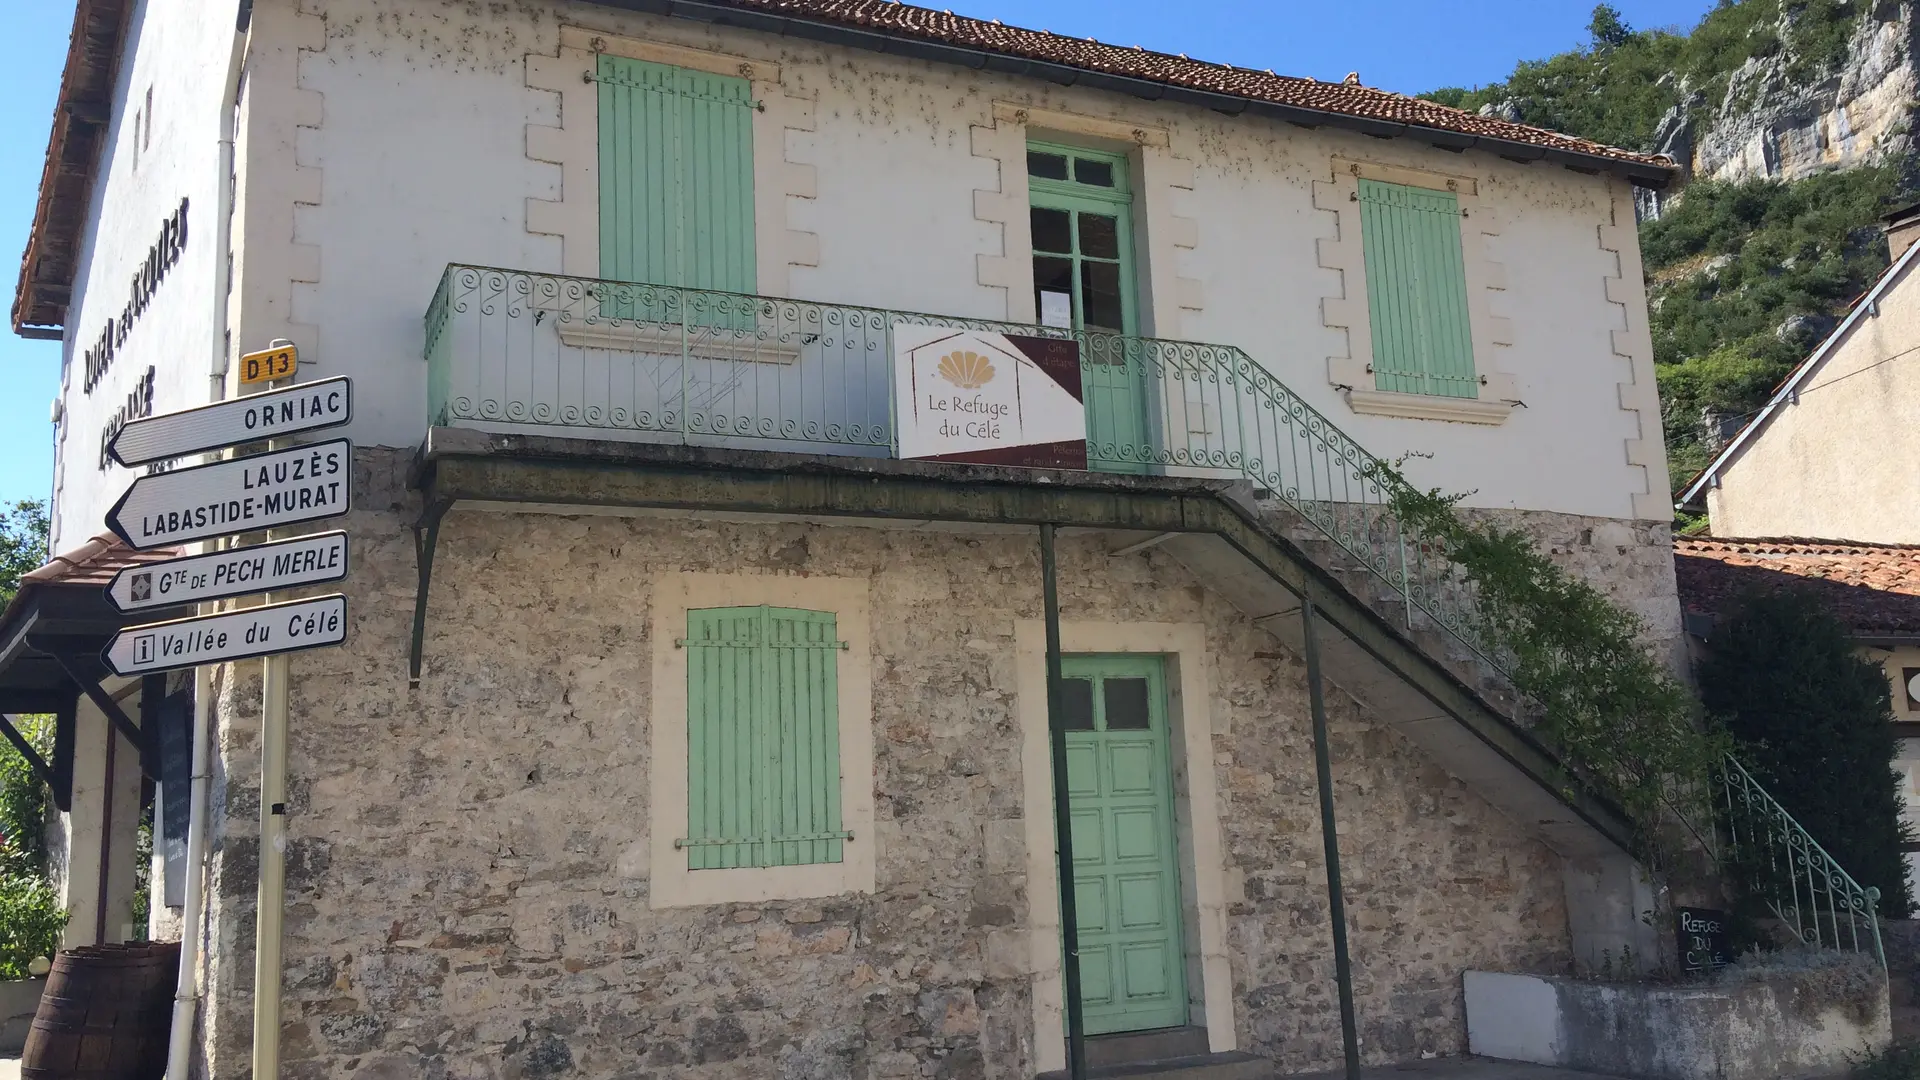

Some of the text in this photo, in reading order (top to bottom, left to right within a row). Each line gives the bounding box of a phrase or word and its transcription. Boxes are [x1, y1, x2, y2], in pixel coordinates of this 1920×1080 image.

[247, 352, 289, 381] D 13
[244, 391, 340, 430] ORNIAC
[929, 394, 1009, 421] Le Refuge
[939, 419, 1001, 440] du Célé
[243, 451, 340, 490] LAUZÈS
[143, 482, 340, 537] LABASTIDE-MURAT
[191, 574, 207, 589] DE
[214, 557, 265, 586] PECH
[272, 546, 340, 577] MERLE
[162, 627, 228, 657] Vallée
[246, 621, 269, 644] du
[288, 608, 339, 638] Célé
[1681, 911, 1723, 933] REFUGE
[1686, 951, 1726, 965] CLÉ
[1693, 936, 1712, 951] DU
